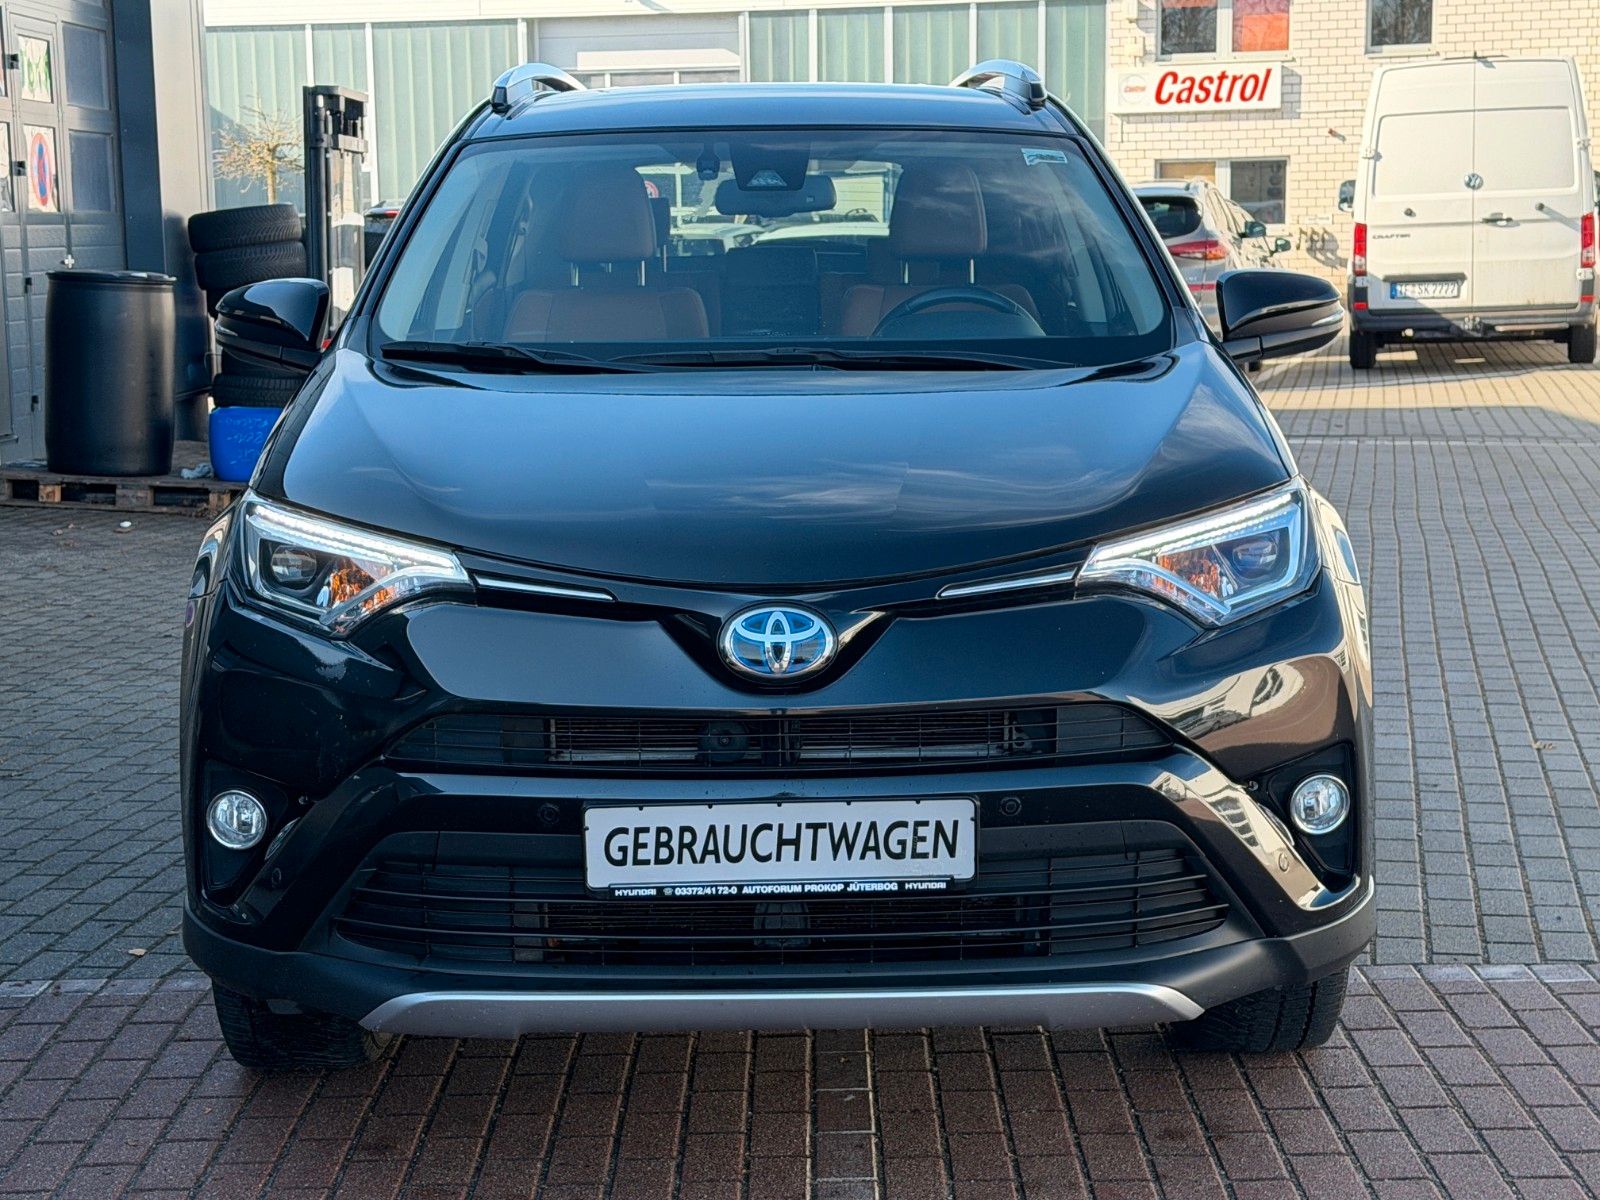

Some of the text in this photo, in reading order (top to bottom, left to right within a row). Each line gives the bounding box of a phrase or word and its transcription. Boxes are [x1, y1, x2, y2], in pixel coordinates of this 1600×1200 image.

[1155, 68, 1272, 105] Castrol
[604, 819, 959, 867] GEBRAUCHTWAGEN
[615, 888, 657, 896] HYUNDAI
[742, 884, 801, 895] AUTOFORUM
[805, 883, 844, 893] PROKOP
[847, 881, 898, 891] JÜTERBOG
[905, 881, 946, 890] HYUNDAI
